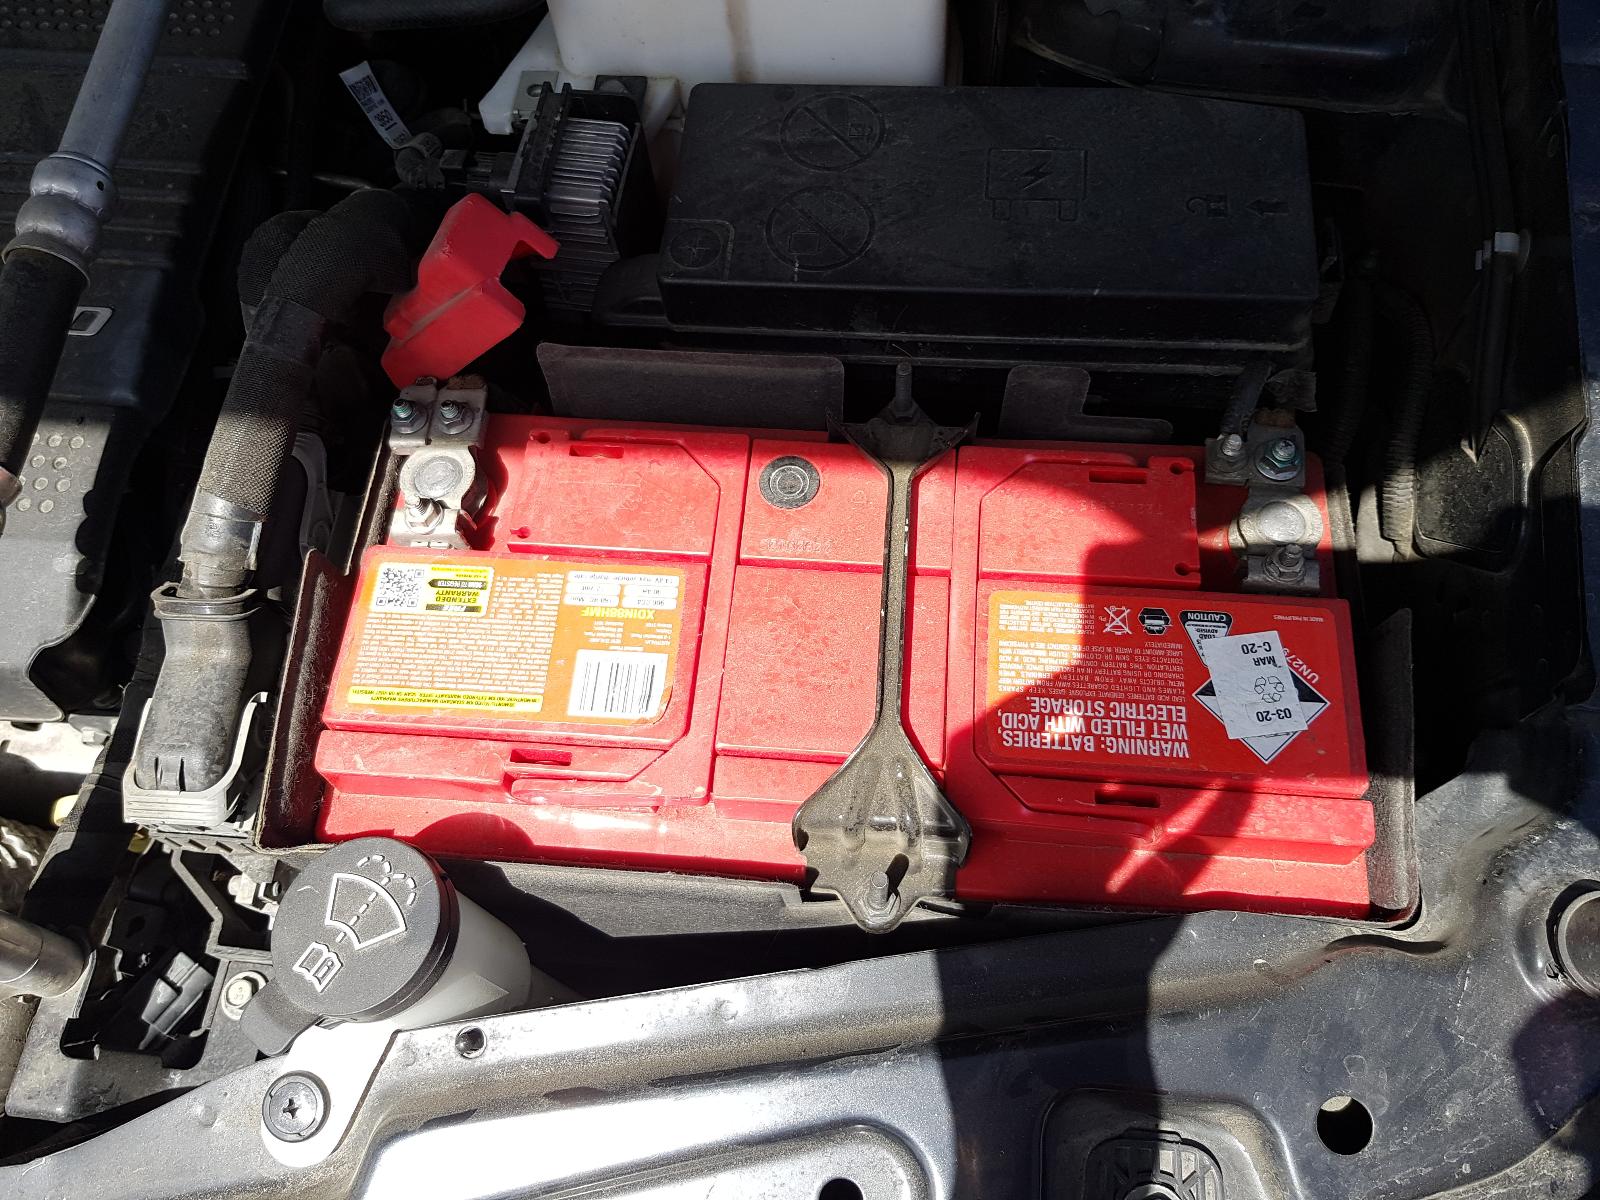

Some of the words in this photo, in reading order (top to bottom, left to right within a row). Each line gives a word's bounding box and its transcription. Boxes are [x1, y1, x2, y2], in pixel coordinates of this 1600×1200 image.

[580, 605, 655, 619] XDIN88HMF
[1187, 612, 1225, 621] CAUTION
[1240, 639, 1271, 655] C-20
[1070, 658, 1097, 666] CONTAINS
[1100, 660, 1126, 668] BATTERY
[1152, 656, 1183, 664] CONTACTS
[1252, 654, 1276, 667] MAR
[1044, 664, 1074, 672] ENCLOSED
[1094, 667, 1120, 675] BATTERY
[1144, 663, 1183, 671] VENTILATION.
[1153, 671, 1183, 679] CHARGING
[998, 684, 1023, 692] SPARKS
[1070, 681, 1108, 689] CIGARETTES
[1126, 692, 1154, 700] BATTERIES
[1025, 695, 1105, 717] STORAGE.
[1109, 701, 1186, 722] ELECTRIC
[997, 708, 1040, 730] ACID,
[1255, 705, 1291, 723] 03-20
[1043, 714, 1085, 733] WITH
[1089, 717, 1145, 737] FILLED
[1149, 721, 1187, 740] WET
[997, 726, 1094, 752] BATTERIES,
[1100, 736, 1189, 758] WARNING:
